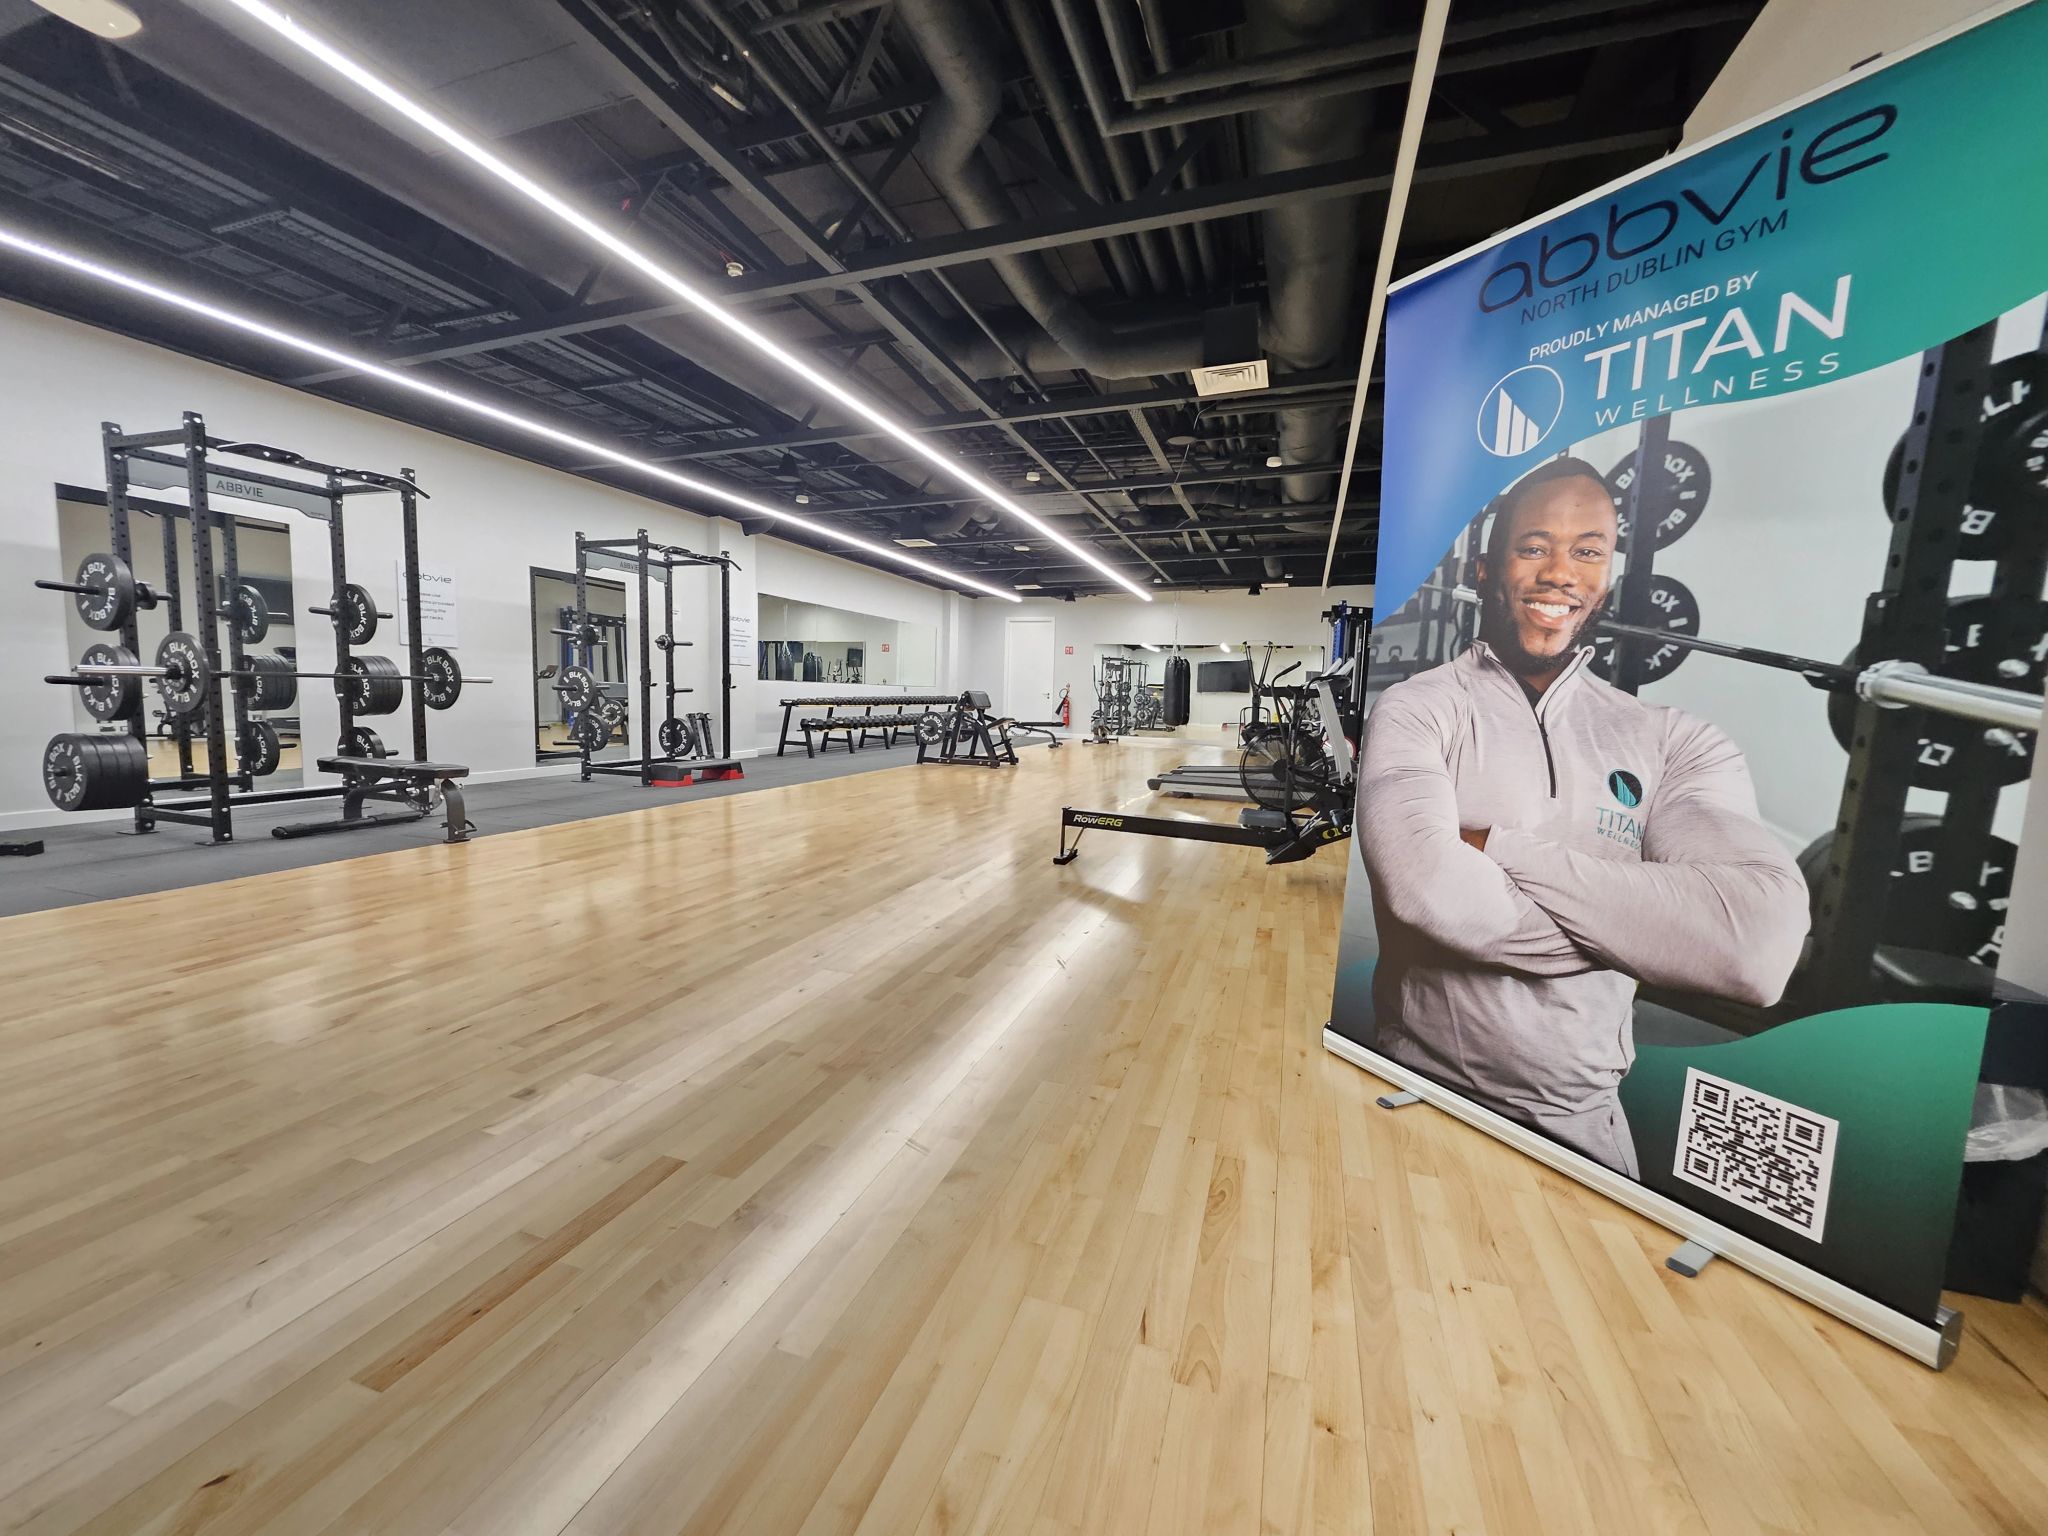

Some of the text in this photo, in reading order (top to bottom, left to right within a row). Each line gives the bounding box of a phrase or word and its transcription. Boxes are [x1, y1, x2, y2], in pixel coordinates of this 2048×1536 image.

[1478, 104, 1898, 314] abbvie
[1520, 209, 1789, 325] NORTH DUBLIN GYM
[1529, 270, 1760, 362] PROUDLY MANAGED BY
[1583, 274, 1853, 400] TITAN
[1594, 352, 1841, 426] WELLNESS
[216, 480, 264, 498] ABBVIE
[168, 642, 188, 654] BLK
[186, 650, 200, 680] BOX
[426, 655, 454, 682] BLK BOX
[568, 671, 590, 694] BLK BOX
[356, 734, 370, 752] BLK
[46, 763, 57, 790] BLK
[72, 755, 83, 782] BLK
[1596, 806, 1645, 840] TITAN
